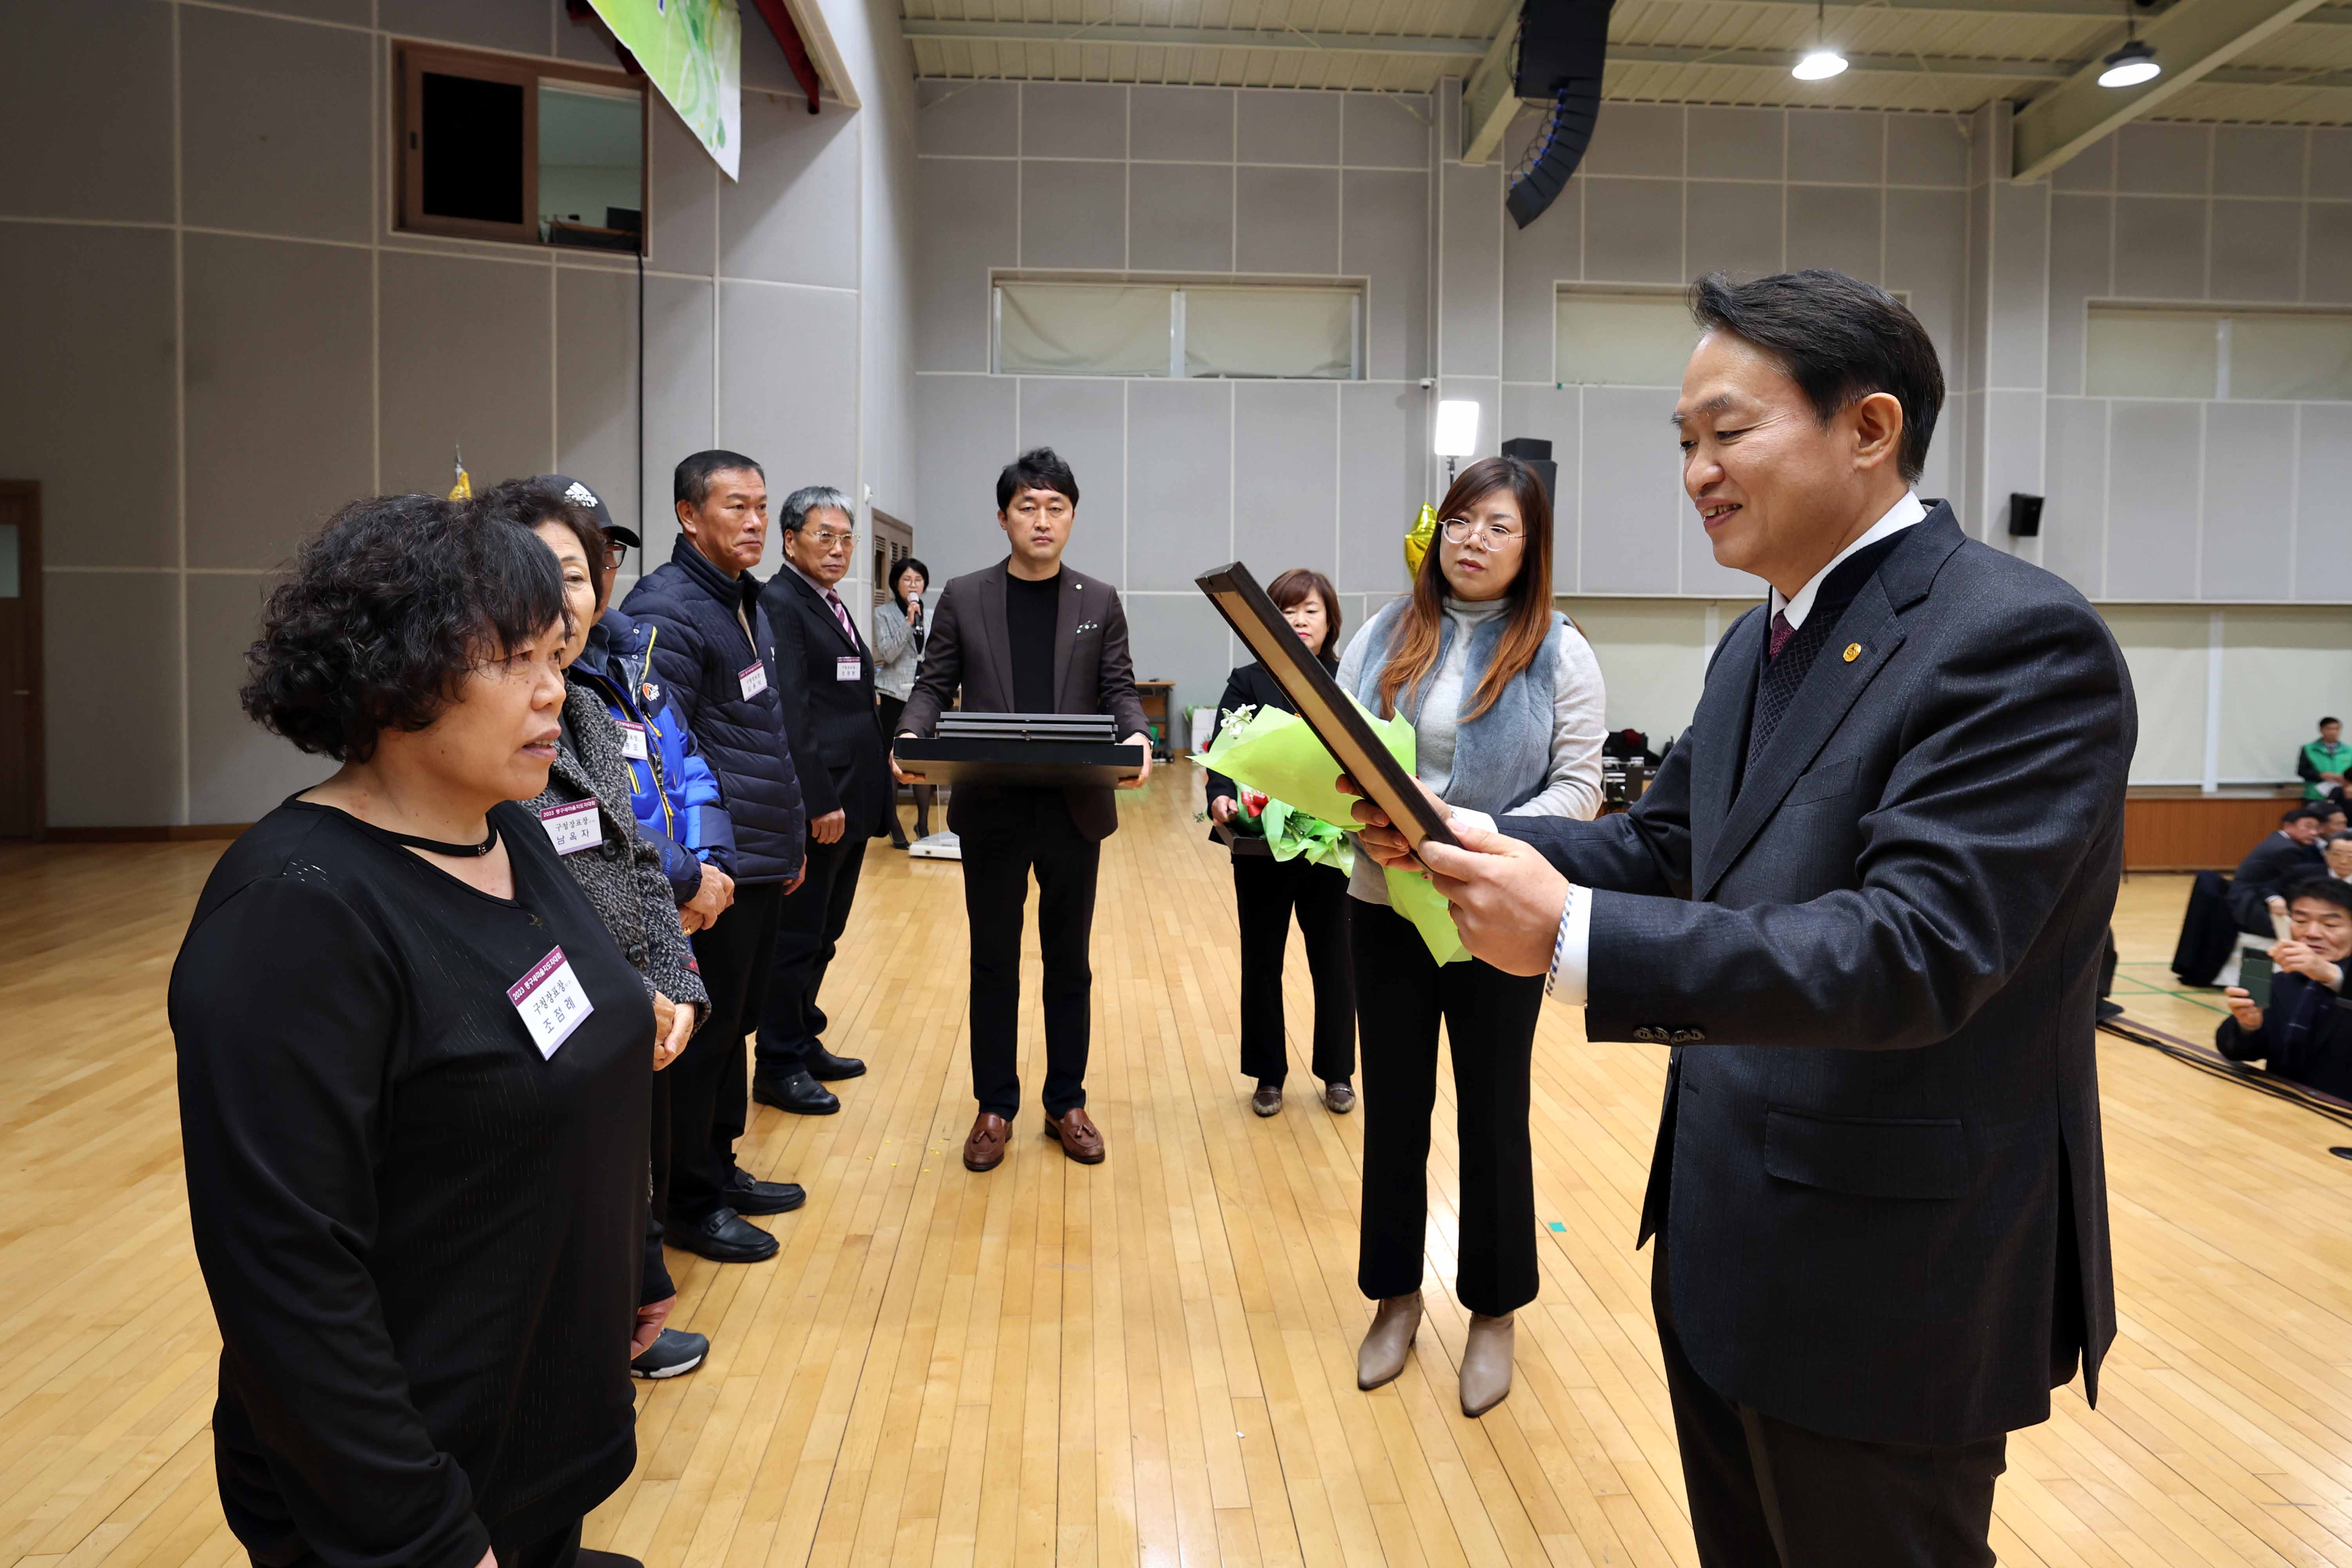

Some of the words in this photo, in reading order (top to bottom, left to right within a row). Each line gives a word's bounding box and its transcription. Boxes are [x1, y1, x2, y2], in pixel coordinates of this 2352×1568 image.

[555, 817, 588, 831] 구청장표창
[512, 986, 525, 1001] 2023
[533, 980, 566, 1015] 구청장표창
